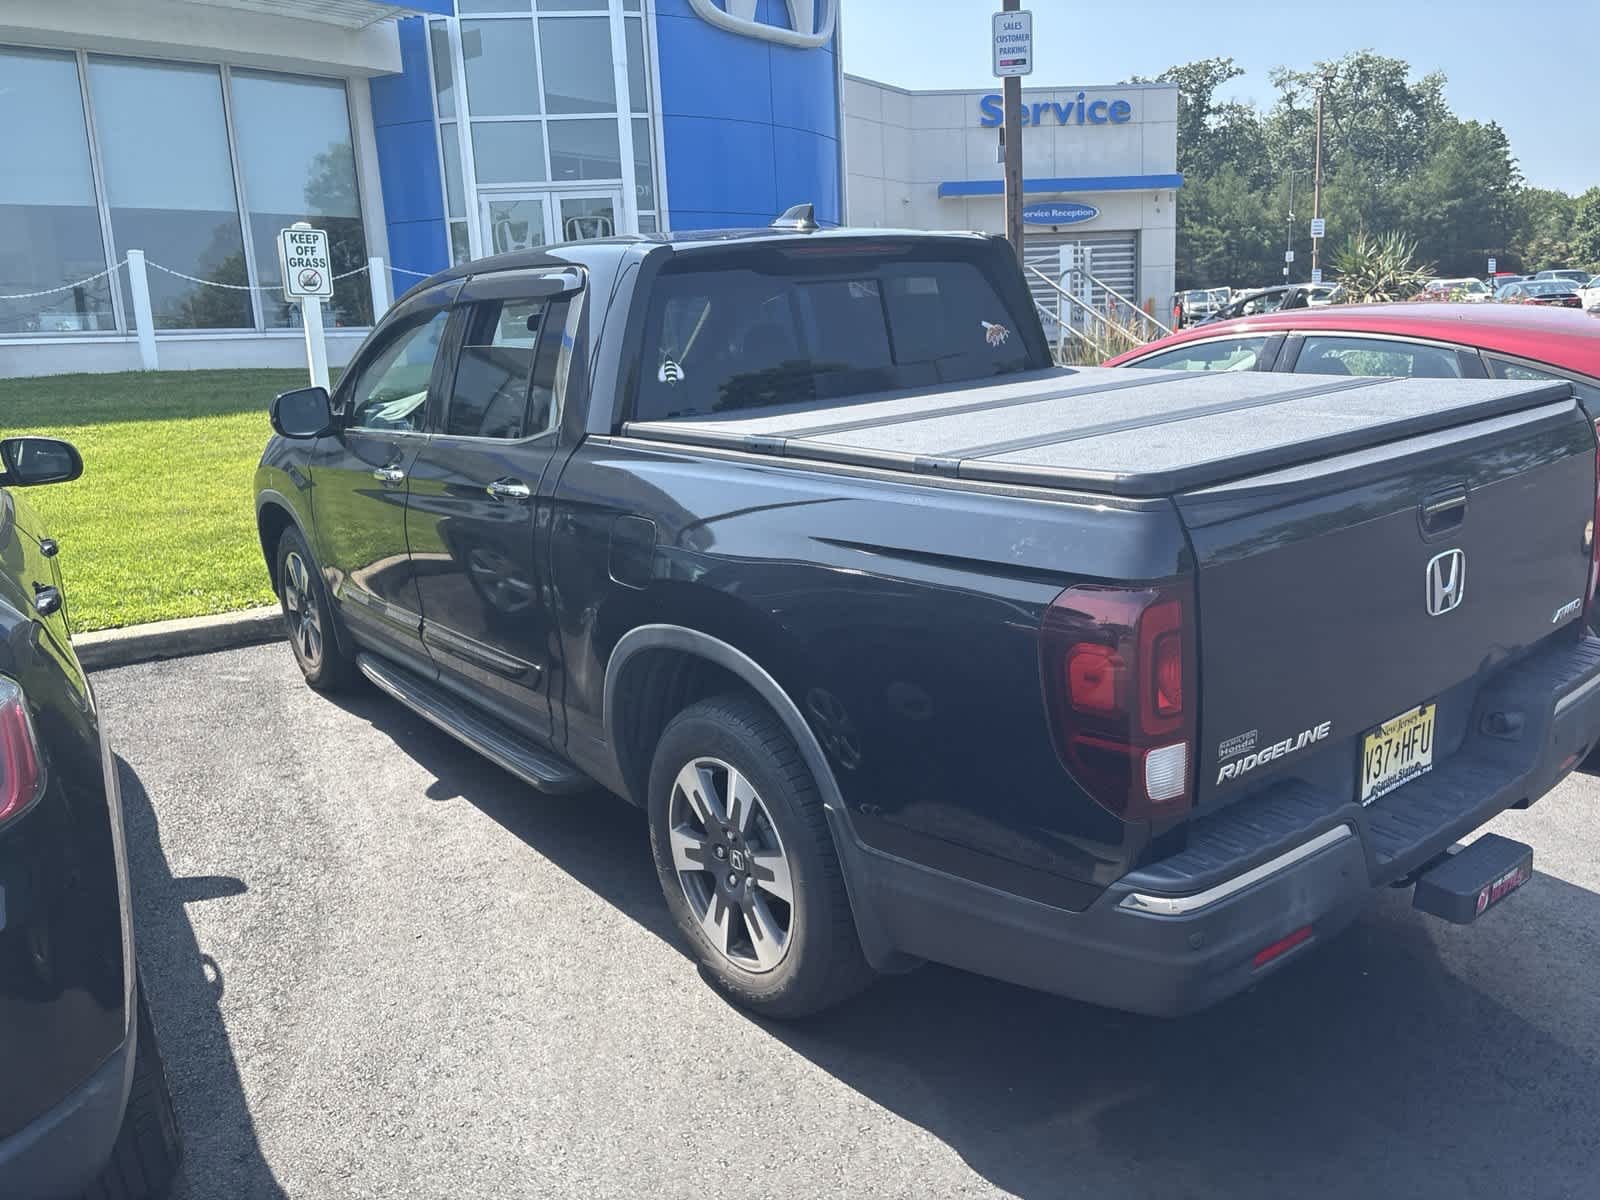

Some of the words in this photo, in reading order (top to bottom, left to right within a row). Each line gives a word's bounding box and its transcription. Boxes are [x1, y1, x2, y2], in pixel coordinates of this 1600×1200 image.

[1003, 21, 1023, 30] SALES
[996, 33, 1030, 43] CUSTOMER
[999, 46, 1027, 55] PARKING
[1051, 208, 1094, 218] Reception
[289, 233, 319, 244] KEEP
[295, 246, 317, 256] OFF
[289, 257, 326, 268] GRASS
[1216, 720, 1331, 785] RIDGELINE
[1220, 738, 1254, 757] Honda
[1366, 738, 1393, 785] V37
[1400, 720, 1432, 766] HFU
